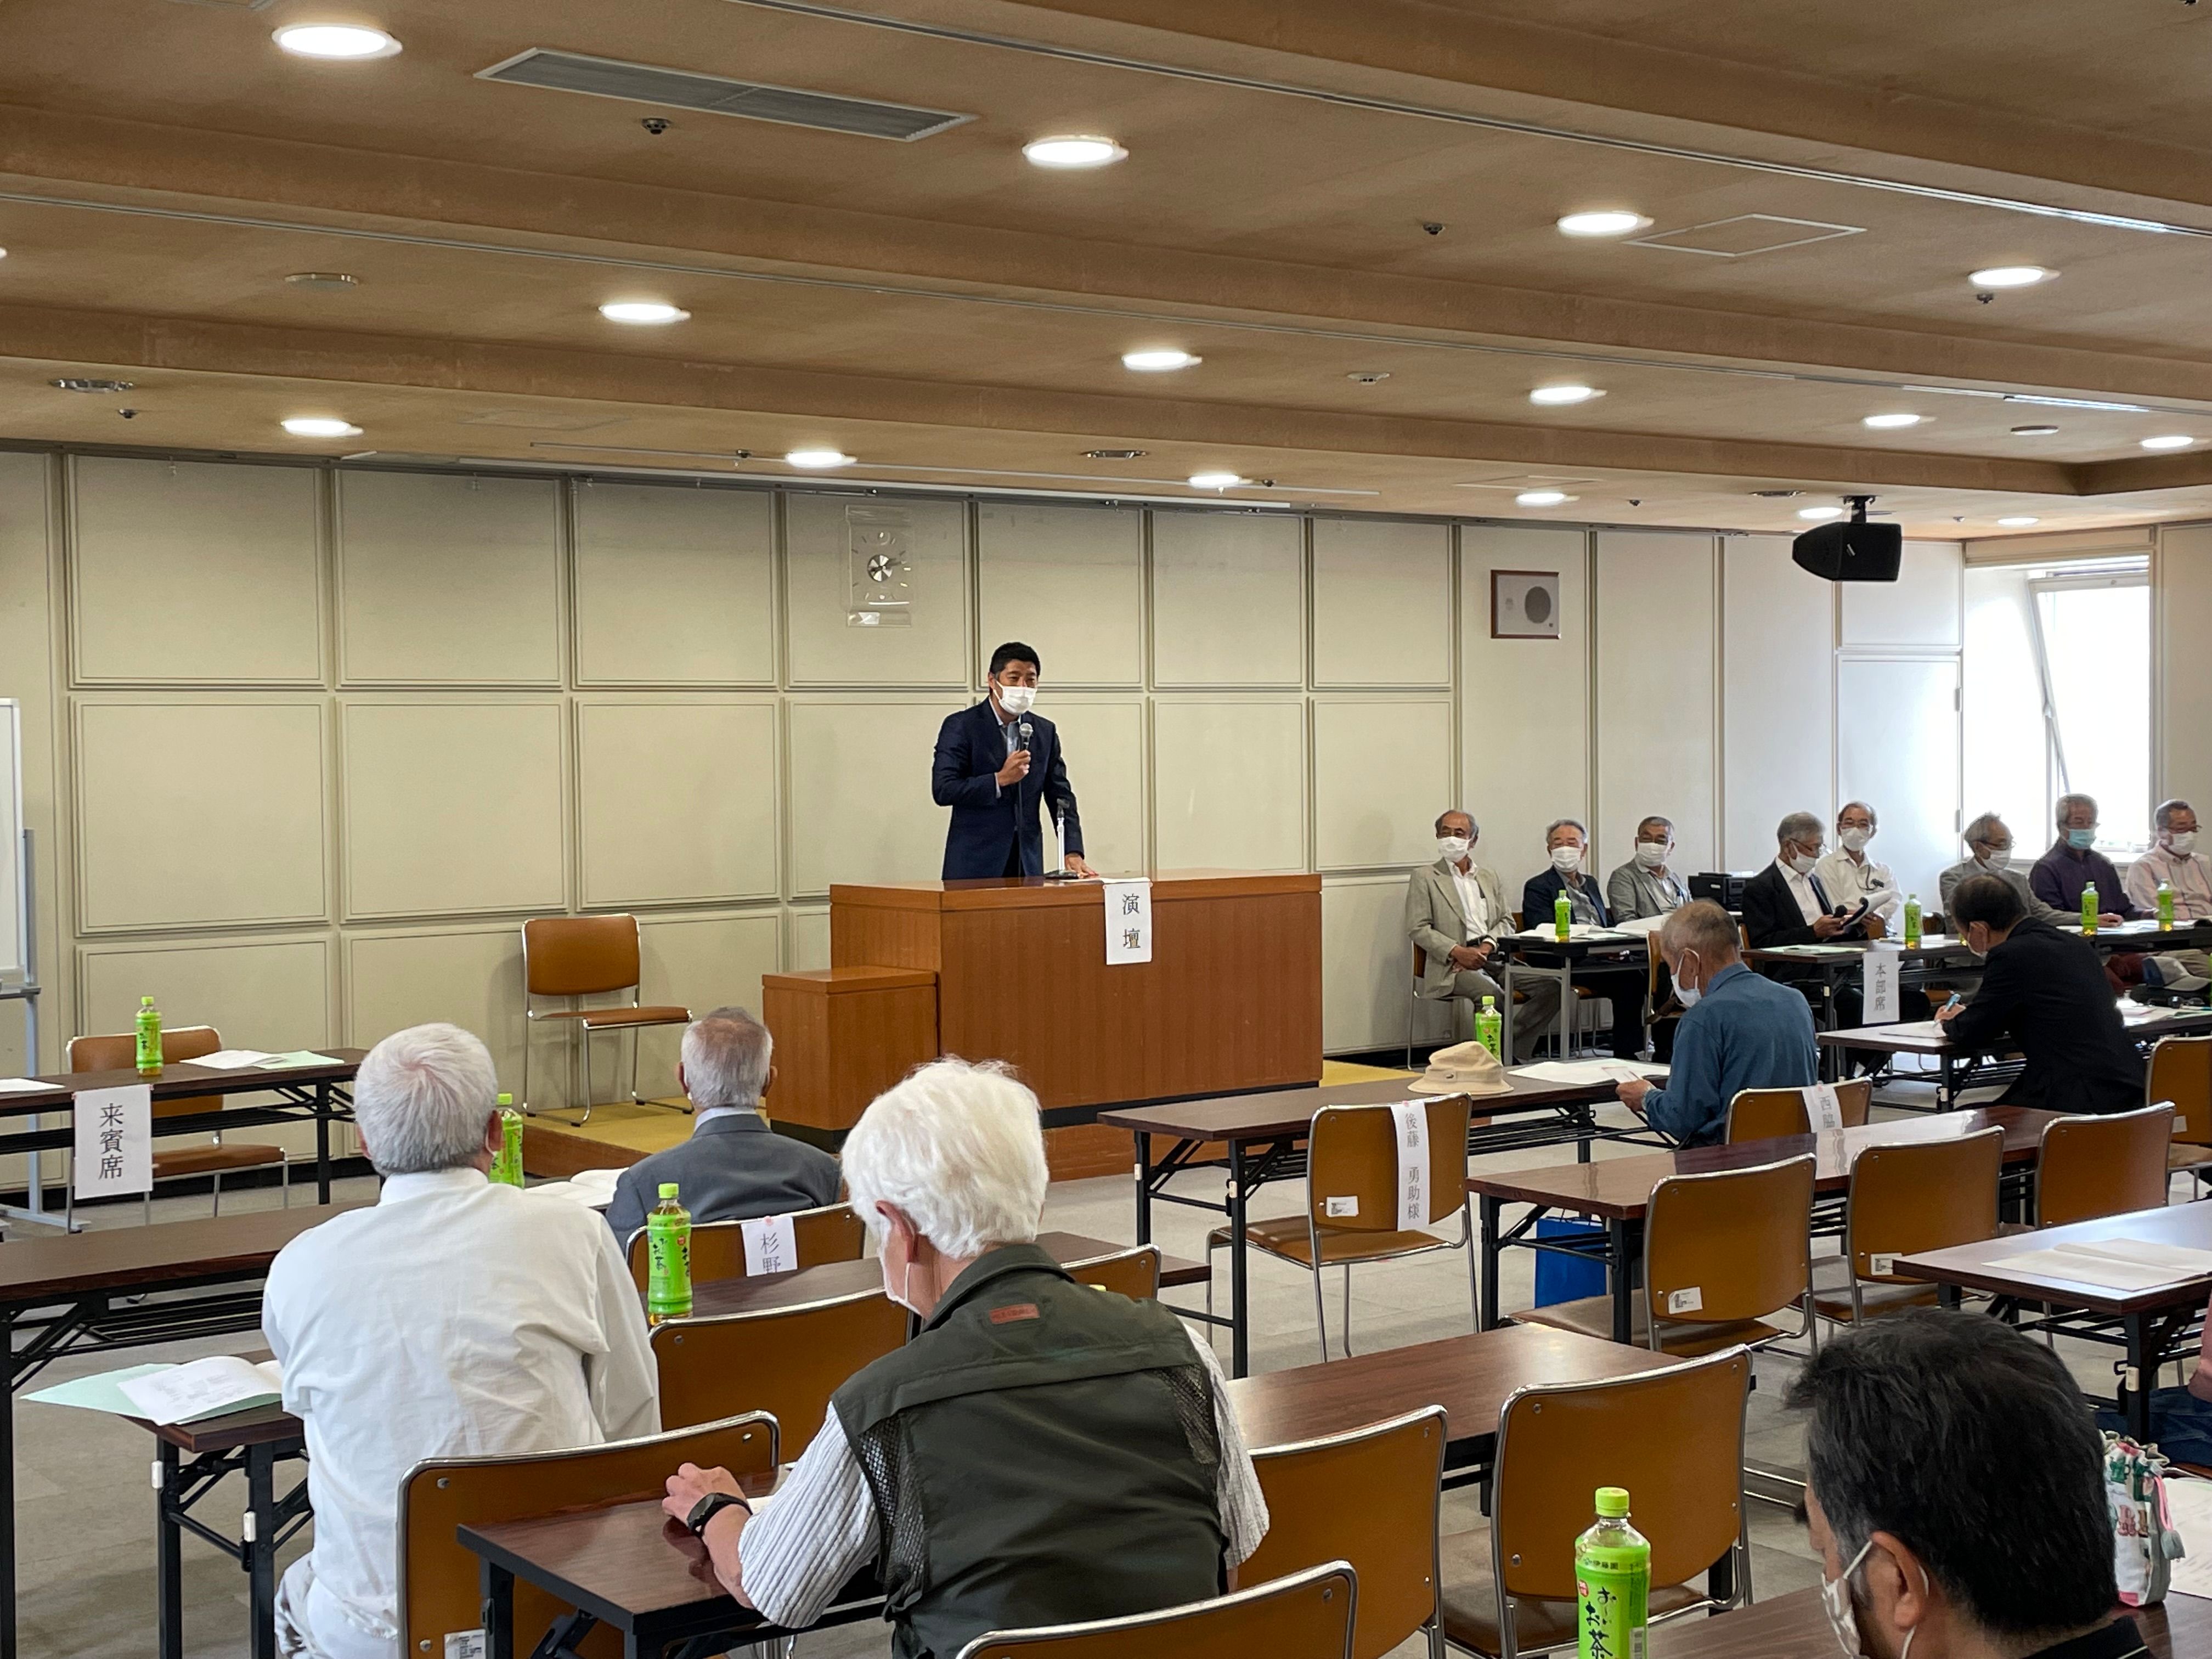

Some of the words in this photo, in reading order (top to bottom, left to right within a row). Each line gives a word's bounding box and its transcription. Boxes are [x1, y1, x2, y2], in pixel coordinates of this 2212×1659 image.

[1122, 893, 1141, 949] 演壇
[1874, 962, 1886, 1011] 本部席
[99, 1103, 123, 1180] 来賓席
[1405, 1113, 1419, 1148] 後藤
[1407, 1166, 1420, 1220] 勇助様
[760, 1232, 781, 1273] 杉野
